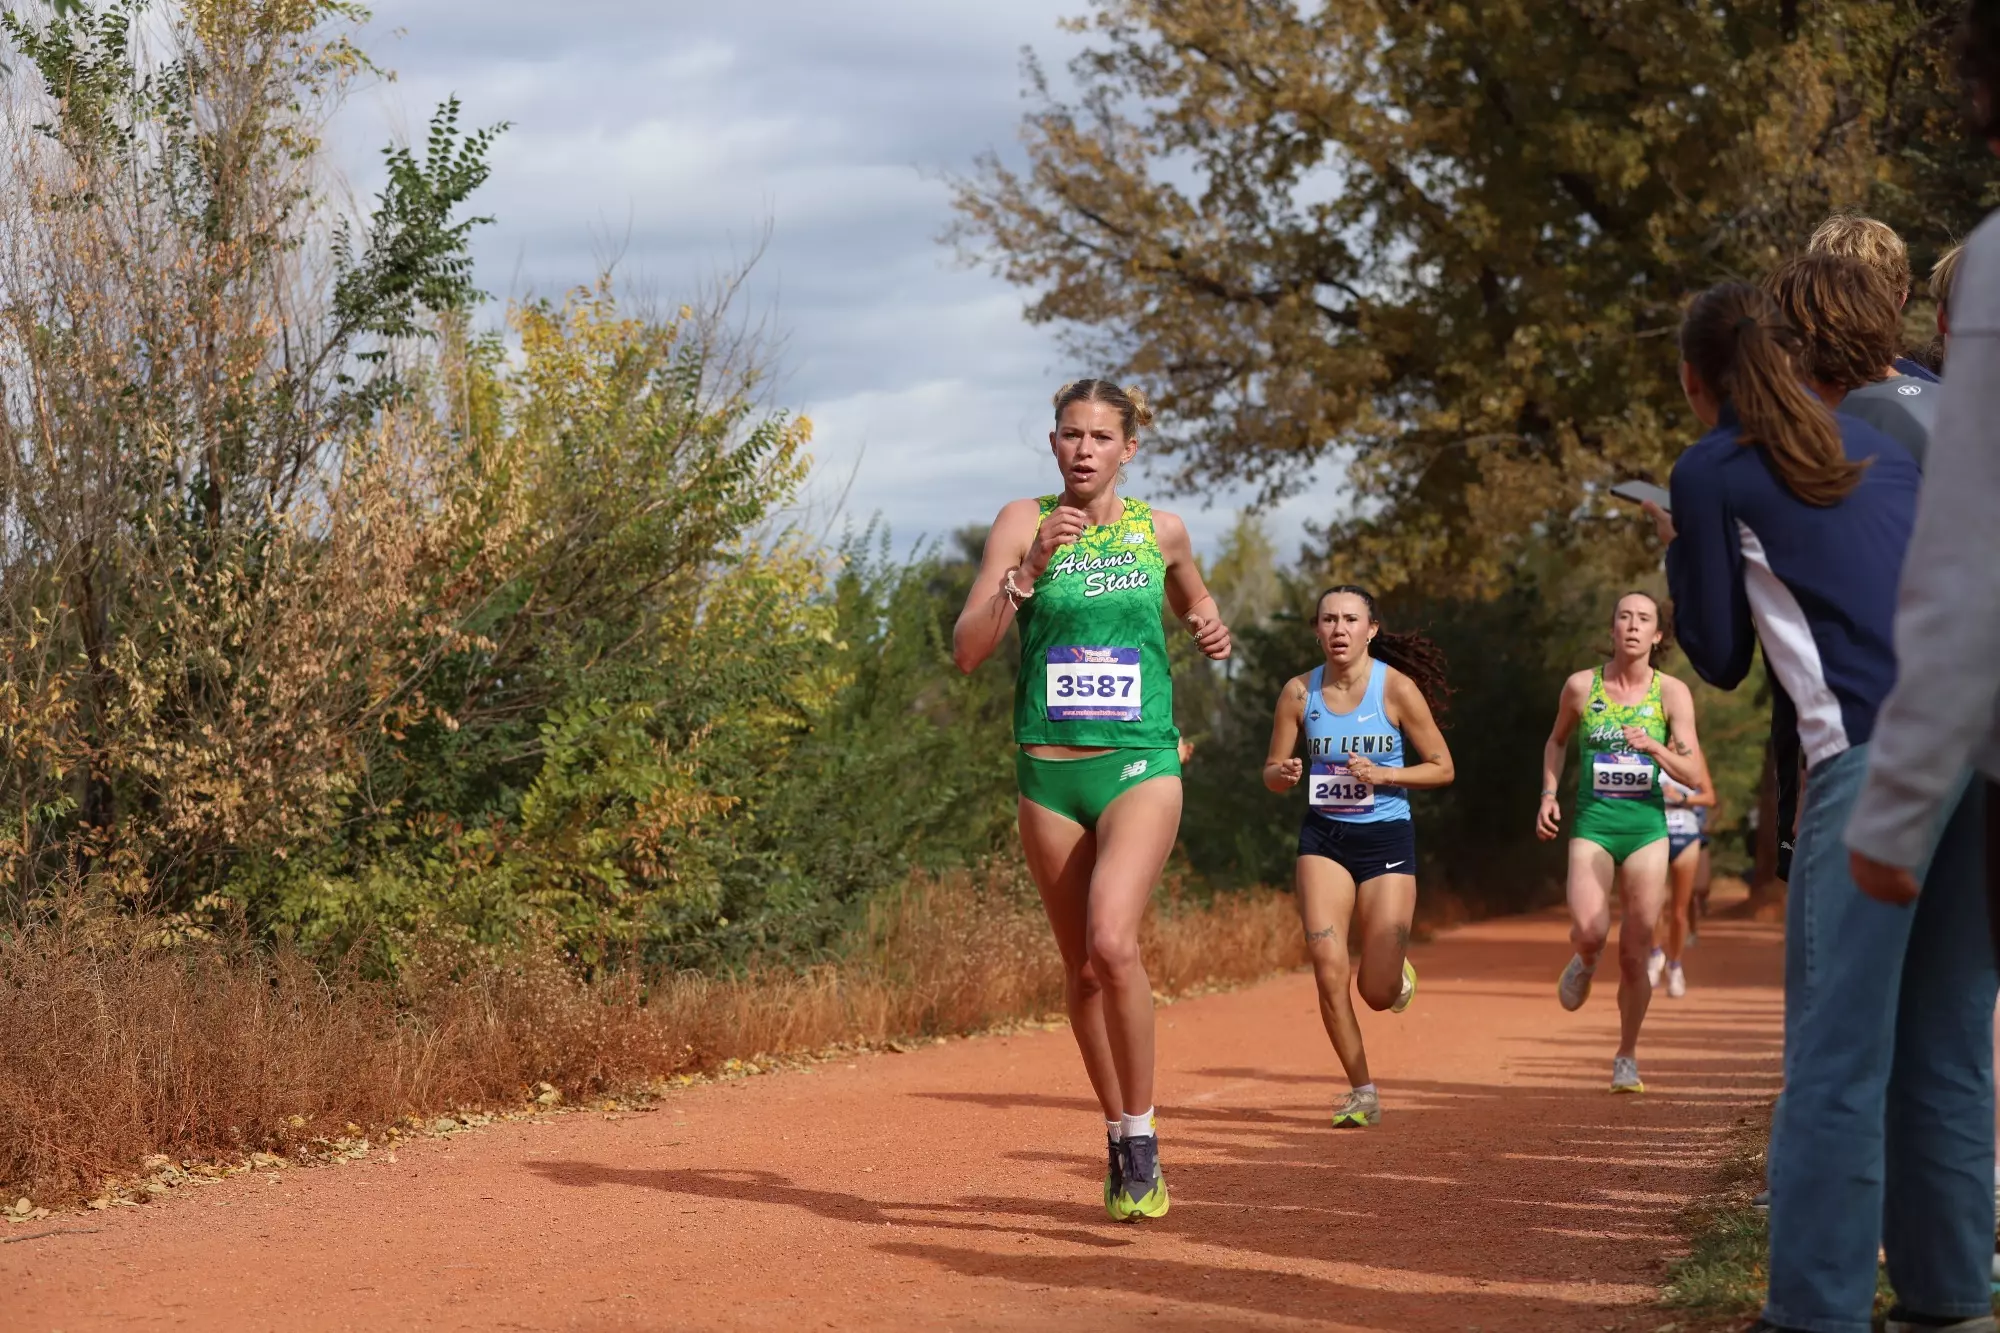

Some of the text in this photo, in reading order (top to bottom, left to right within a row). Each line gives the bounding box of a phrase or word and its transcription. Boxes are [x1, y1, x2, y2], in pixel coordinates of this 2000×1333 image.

[1051, 551, 1137, 580] Adams
[1083, 568, 1149, 597] State
[1056, 674, 1135, 698] 3587
[1308, 735, 1394, 755] ORT LEWIS
[1598, 771, 1648, 786] 3592
[1315, 783, 1368, 800] 2418
